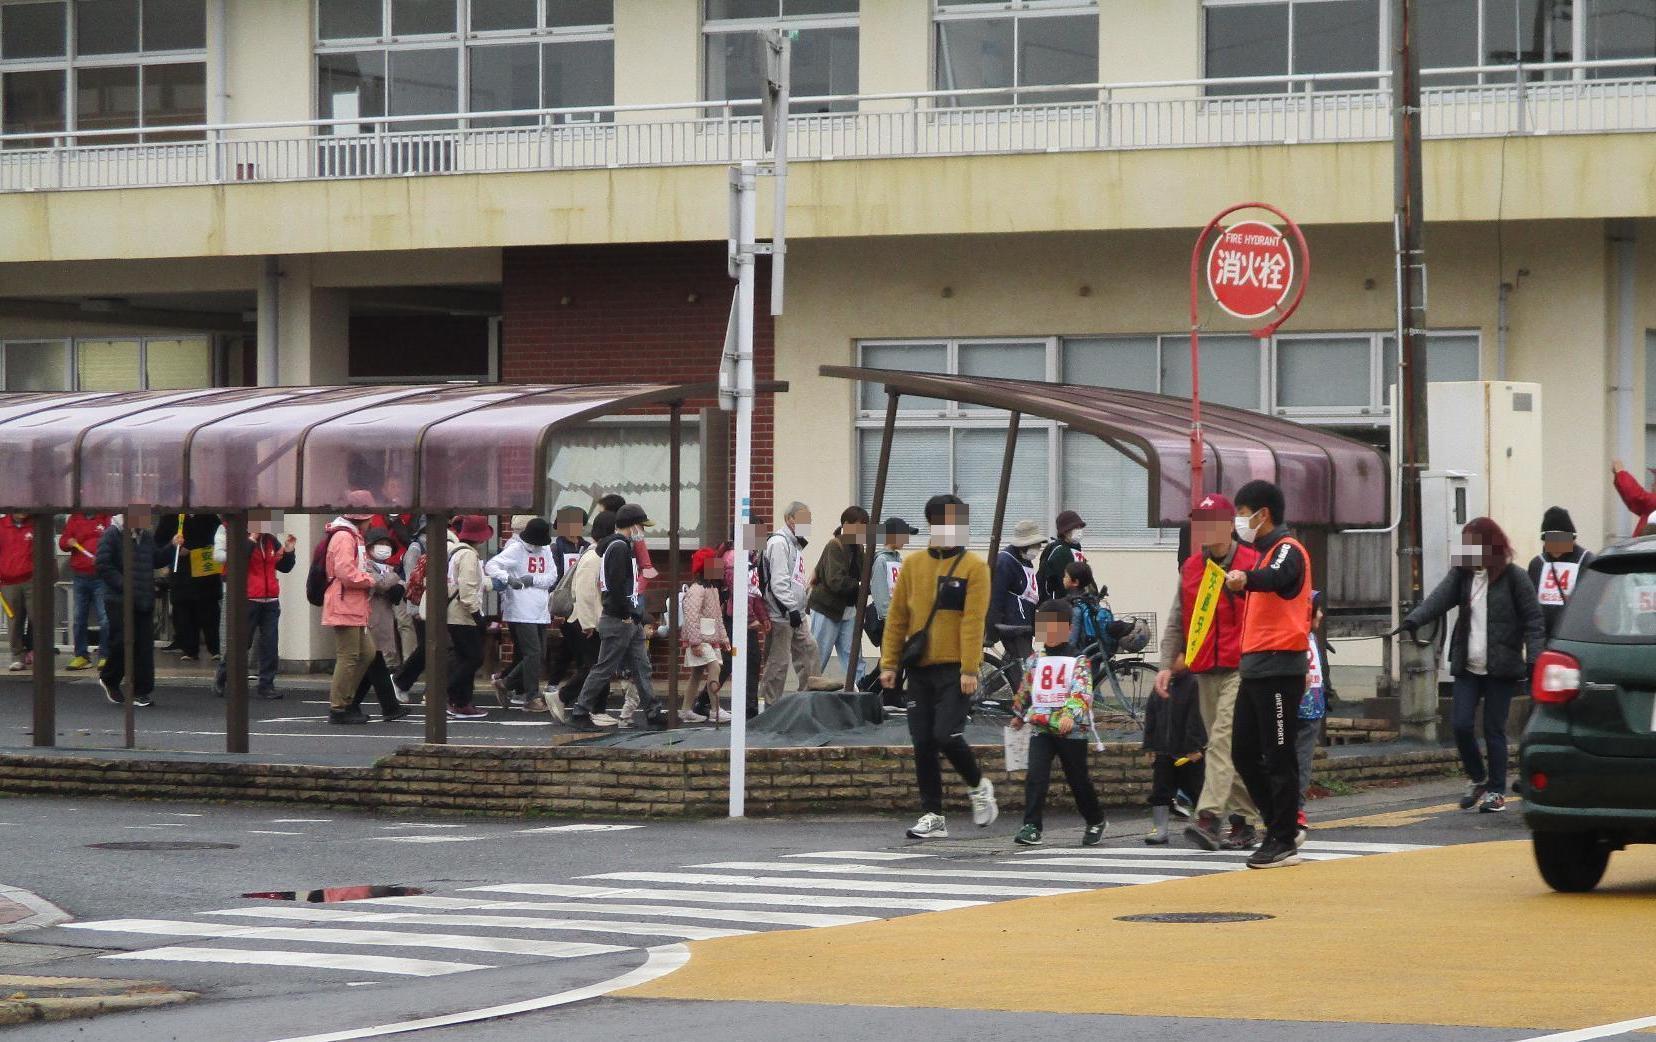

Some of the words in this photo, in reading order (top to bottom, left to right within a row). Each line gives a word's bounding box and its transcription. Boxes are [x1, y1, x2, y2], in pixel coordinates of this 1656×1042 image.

[1226, 233, 1242, 244] FIRE
[1245, 234, 1280, 246] HYDRANT
[1216, 249, 1285, 289] 消火栓
[528, 557, 545, 574] 63
[1544, 569, 1570, 591] 54
[1041, 664, 1067, 690] 84
